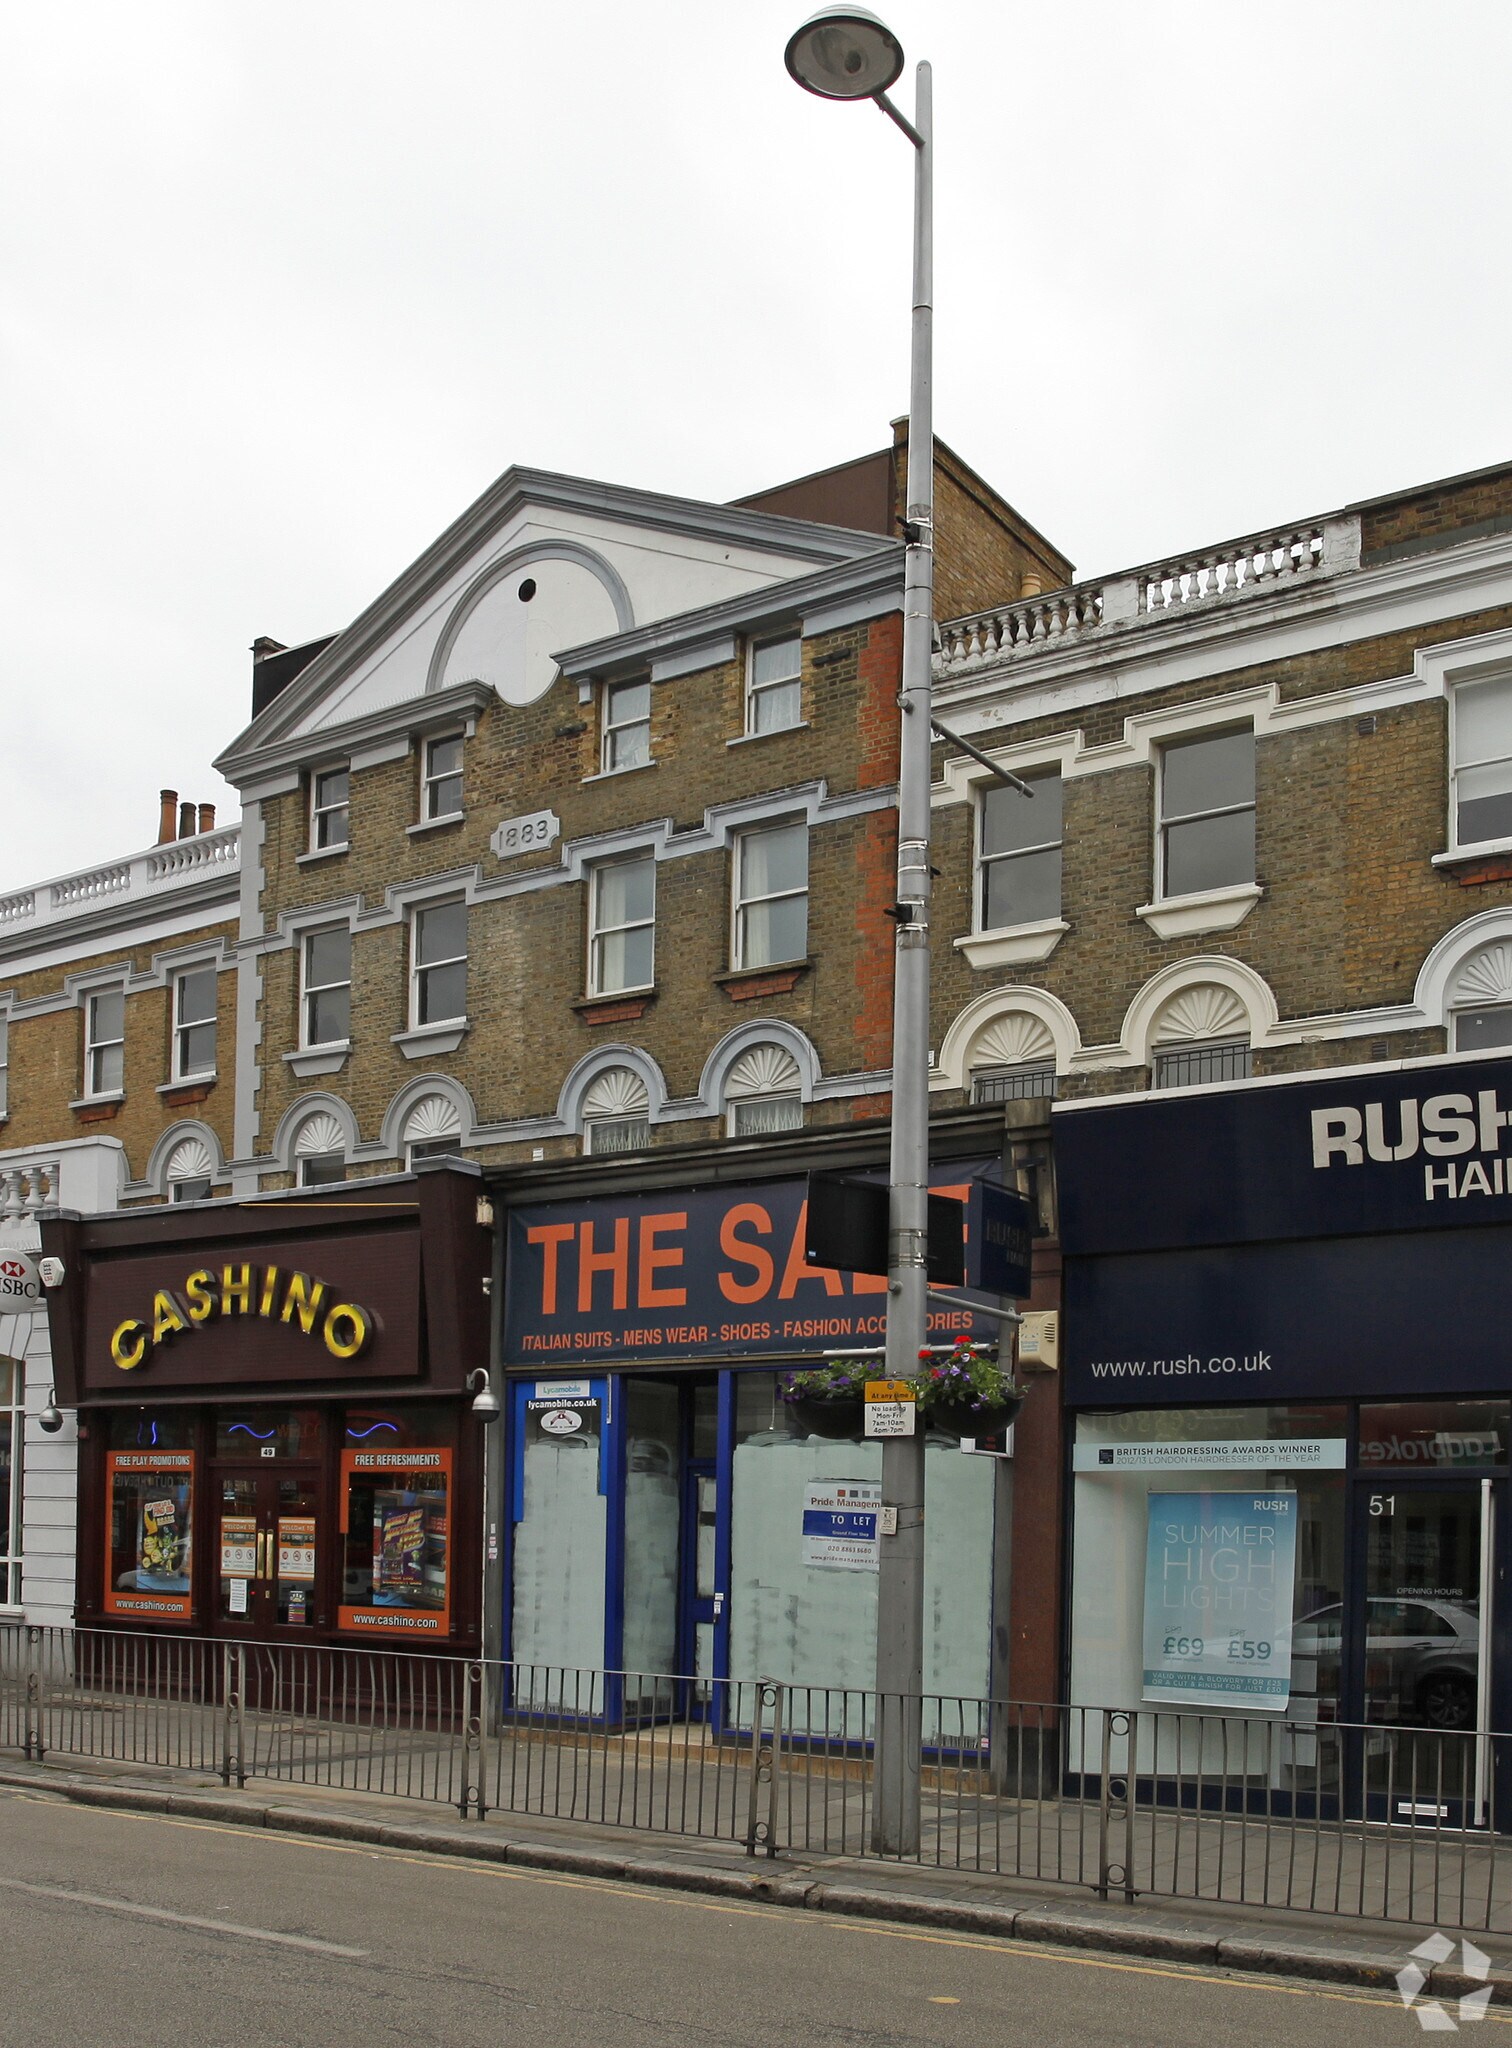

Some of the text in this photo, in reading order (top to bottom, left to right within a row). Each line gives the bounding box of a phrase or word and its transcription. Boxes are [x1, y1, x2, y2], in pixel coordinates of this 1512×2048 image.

[499, 820, 549, 850] 1883
[1424, 1158, 1512, 1201] HAI
[527, 1211, 688, 1315] THE
[0, 1278, 36, 1298] SBC
[111, 1262, 371, 1370] CASHINO
[522, 1333, 571, 1350] ITALIAN
[574, 1331, 612, 1348] SUITS
[624, 1328, 662, 1346] MENS
[666, 1326, 708, 1343] WEAR
[720, 1322, 770, 1341] SHOES
[783, 1318, 851, 1338] FASHION
[1091, 1351, 1272, 1377] www.rush.co.uk
[543, 1385, 581, 1394] Lycamobile
[528, 1399, 597, 1410] lycamobile.co.uk
[1117, 1445, 1321, 1456] BRITISH HAIRDRESSING AWARDS WINNER
[115, 1456, 190, 1465] FREE PLAY PROMOTIONS
[355, 1454, 440, 1465] FREE REFRESHMENTS
[1116, 1456, 1147, 1465] 2012/13
[1149, 1456, 1188, 1464] LONDON
[1190, 1455, 1254, 1464] HAIRDRESSER
[1257, 1455, 1270, 1463] OF
[1294, 1454, 1321, 1462] YEAR
[811, 1497, 834, 1506] Pride
[1253, 1500, 1288, 1511] RUSH
[1368, 1495, 1396, 1516] 51
[831, 1515, 871, 1526] TO LET
[1165, 1524, 1275, 1546] SUMMER
[1164, 1547, 1275, 1584] HIGH
[1163, 1585, 1274, 1611] LIGHTS
[1396, 1587, 1463, 1596] OPENING HOURS
[116, 1600, 183, 1612] www.cashino.com
[353, 1614, 438, 1628] www.cashino.com
[1163, 1637, 1271, 1660] £69 £59
[1206, 1676, 1244, 1684] BLOWDRY
